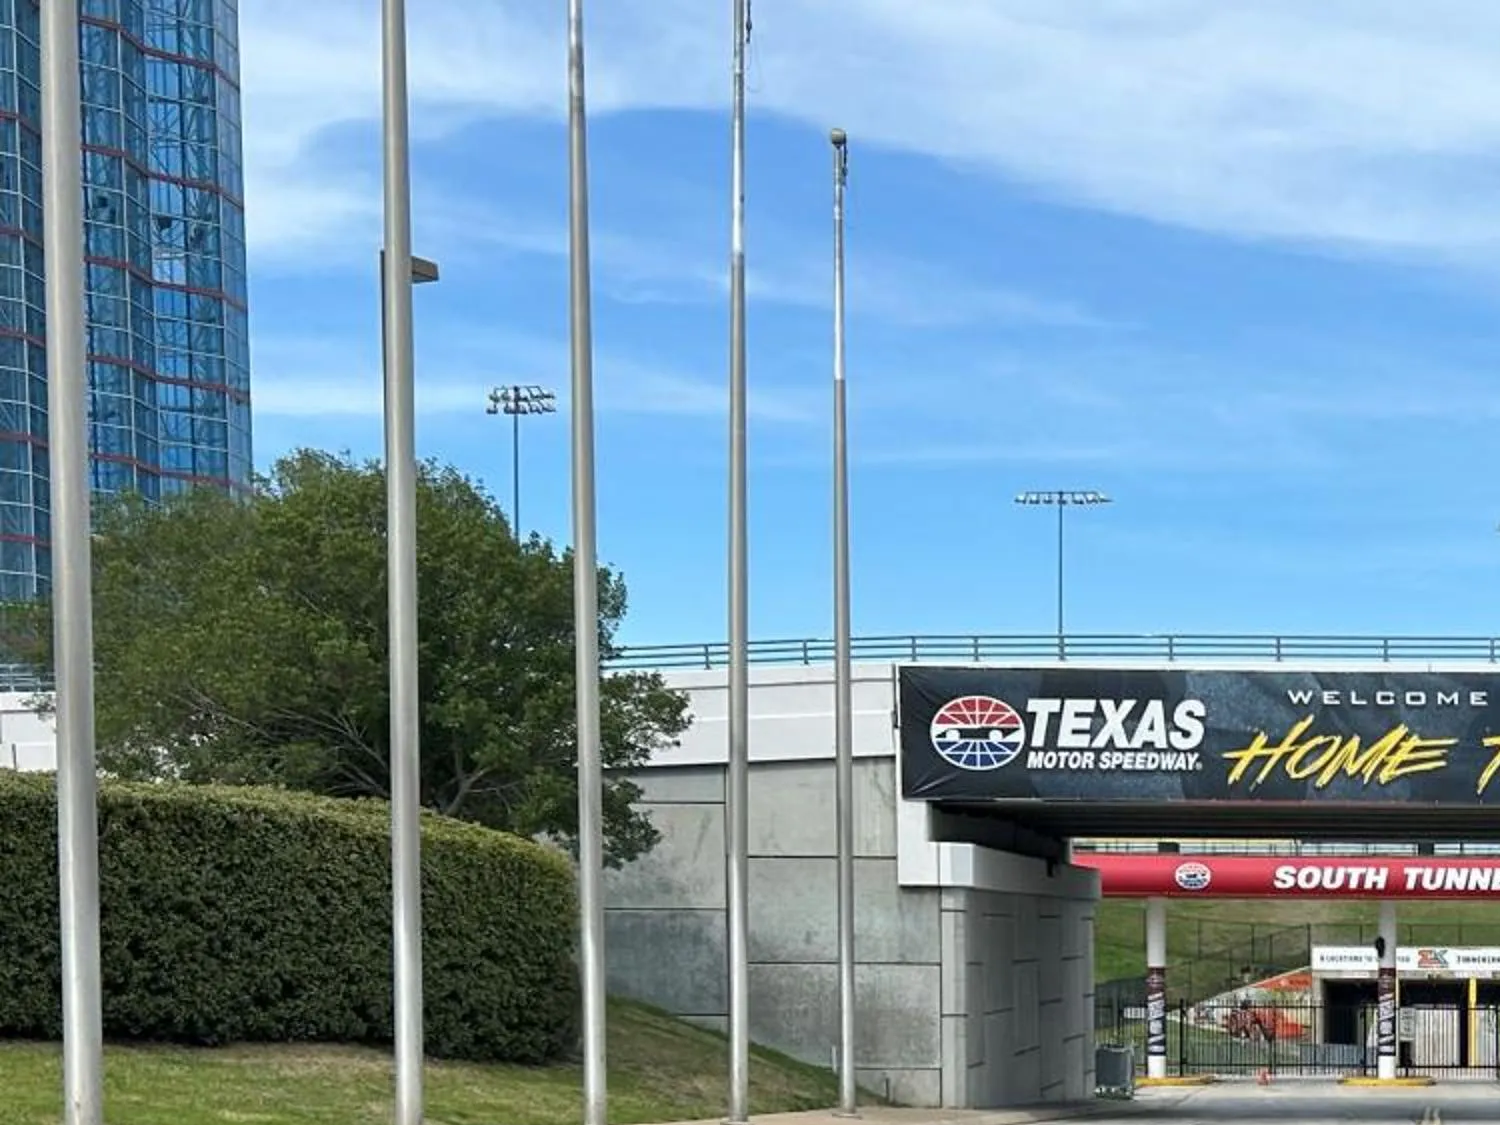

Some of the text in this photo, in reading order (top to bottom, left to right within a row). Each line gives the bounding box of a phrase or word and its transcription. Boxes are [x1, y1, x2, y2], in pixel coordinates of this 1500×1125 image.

[1288, 690, 1489, 706] WELCOME
[1026, 699, 1206, 750] TEXAS
[1027, 752, 1094, 770] MOTOR
[1221, 714, 1459, 791] HOME
[1274, 866, 1388, 890] SOUTH
